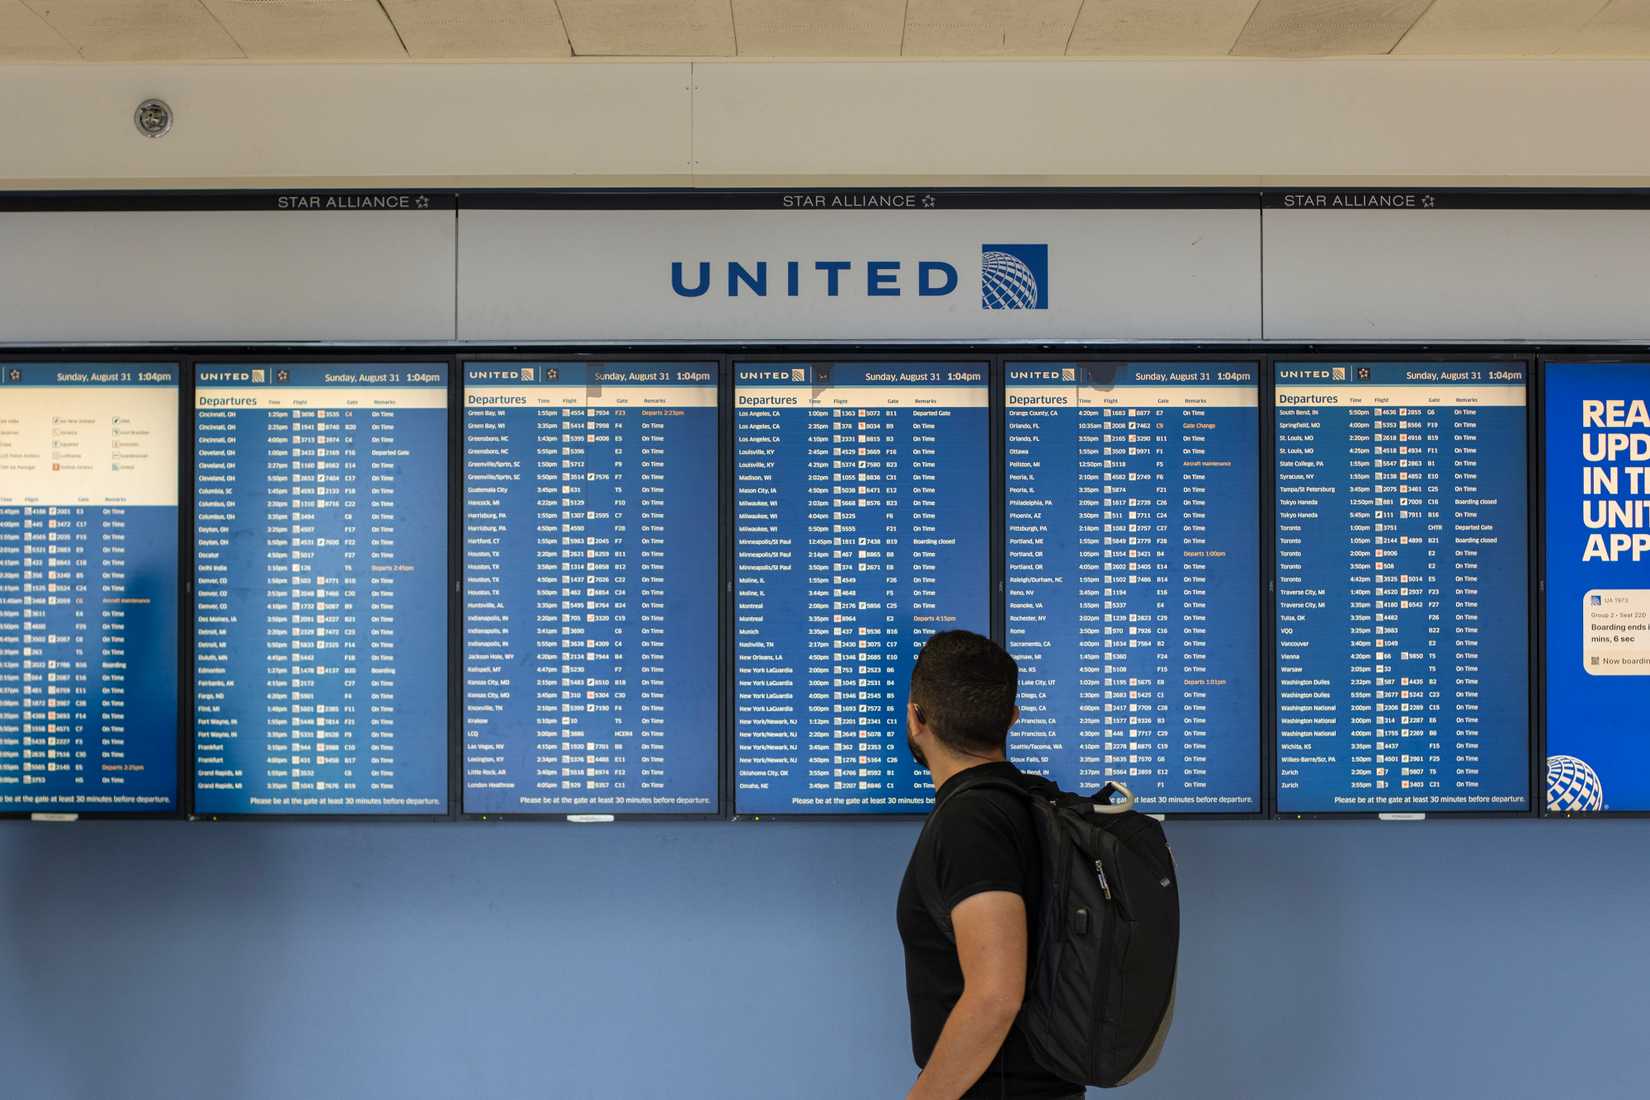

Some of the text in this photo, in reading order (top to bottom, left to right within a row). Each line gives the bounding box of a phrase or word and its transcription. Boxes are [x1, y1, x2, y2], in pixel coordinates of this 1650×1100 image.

[278, 196, 409, 208] STAR ALLIANCE
[783, 195, 916, 207] STAR ALLIANCE
[1284, 194, 1415, 206] STAR ALLIANCE
[672, 262, 958, 297] UNITED
[57, 373, 88, 382] Sunday,
[91, 373, 118, 382] August
[138, 372, 171, 382] 1:04pm
[325, 374, 357, 382] Sunday,
[359, 374, 386, 382] August
[407, 374, 440, 382] 1:04pm
[596, 372, 626, 381] Sunday,
[629, 372, 656, 381] August
[678, 372, 710, 381] 1:04pm
[866, 373, 897, 382] Sunday,
[900, 373, 928, 382] August
[948, 372, 980, 382] 1:04pm
[1136, 372, 1167, 381] Sunday,
[1170, 373, 1197, 381] August
[1218, 372, 1250, 381] 1:04pm
[1407, 372, 1438, 380] Sunday,
[1441, 372, 1468, 380] August
[1489, 372, 1522, 380] 1:04pm
[200, 397, 256, 406] Departures
[468, 395, 526, 405] Departures
[739, 396, 797, 406] Departures
[1010, 395, 1067, 405] Departures
[1280, 394, 1338, 405] Departures
[1592, 624, 1626, 632] Boarding
[1592, 636, 1612, 644] mins,
